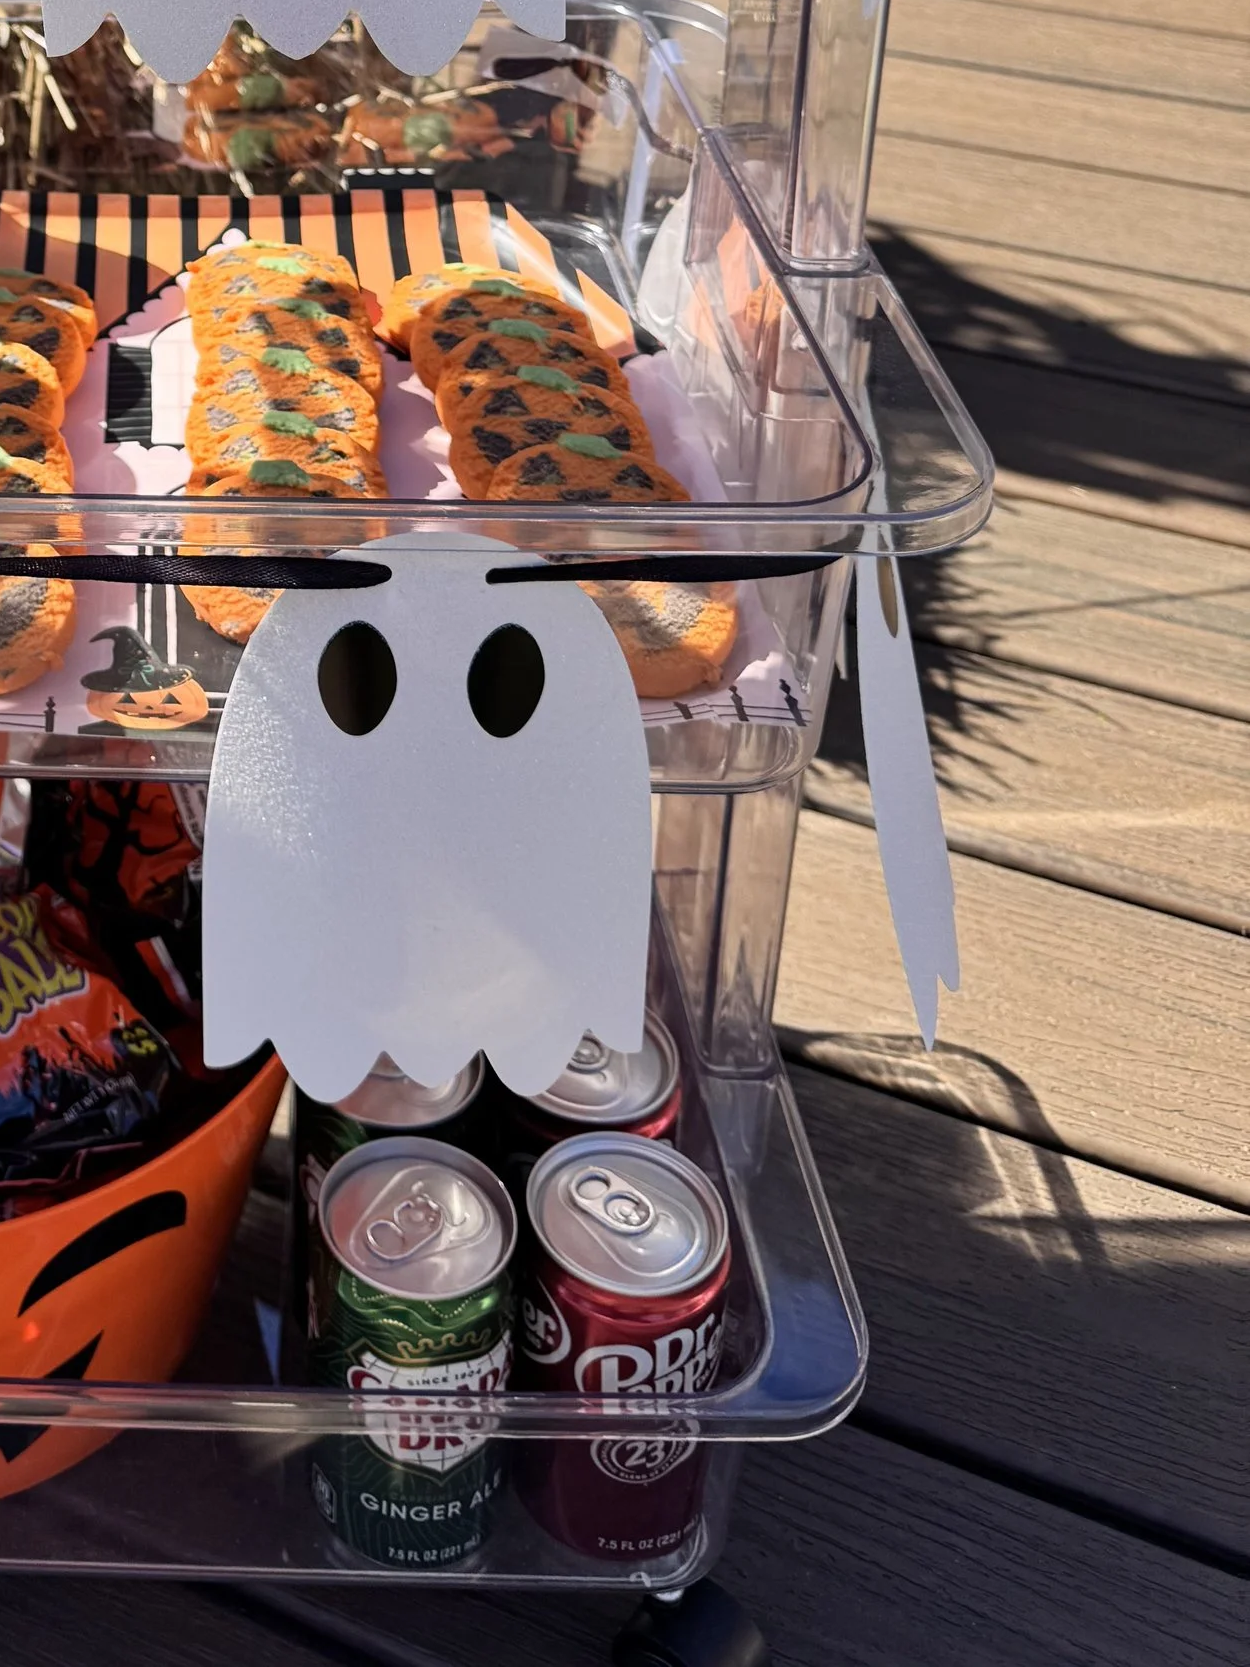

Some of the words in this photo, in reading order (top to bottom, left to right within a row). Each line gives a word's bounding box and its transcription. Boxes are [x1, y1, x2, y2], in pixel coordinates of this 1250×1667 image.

[654, 1313, 717, 1380] Dr
[407, 1376, 449, 1387] SINCE
[624, 1440, 666, 1469] 23
[359, 1491, 462, 1522] GINGER
[387, 1546, 405, 1561] 7.5
[406, 1548, 421, 1562] FL
[422, 1548, 438, 1562] OZ
[597, 1536, 619, 1551] 7.5
[620, 1539, 636, 1551] FL
[637, 1538, 655, 1550] OZ
